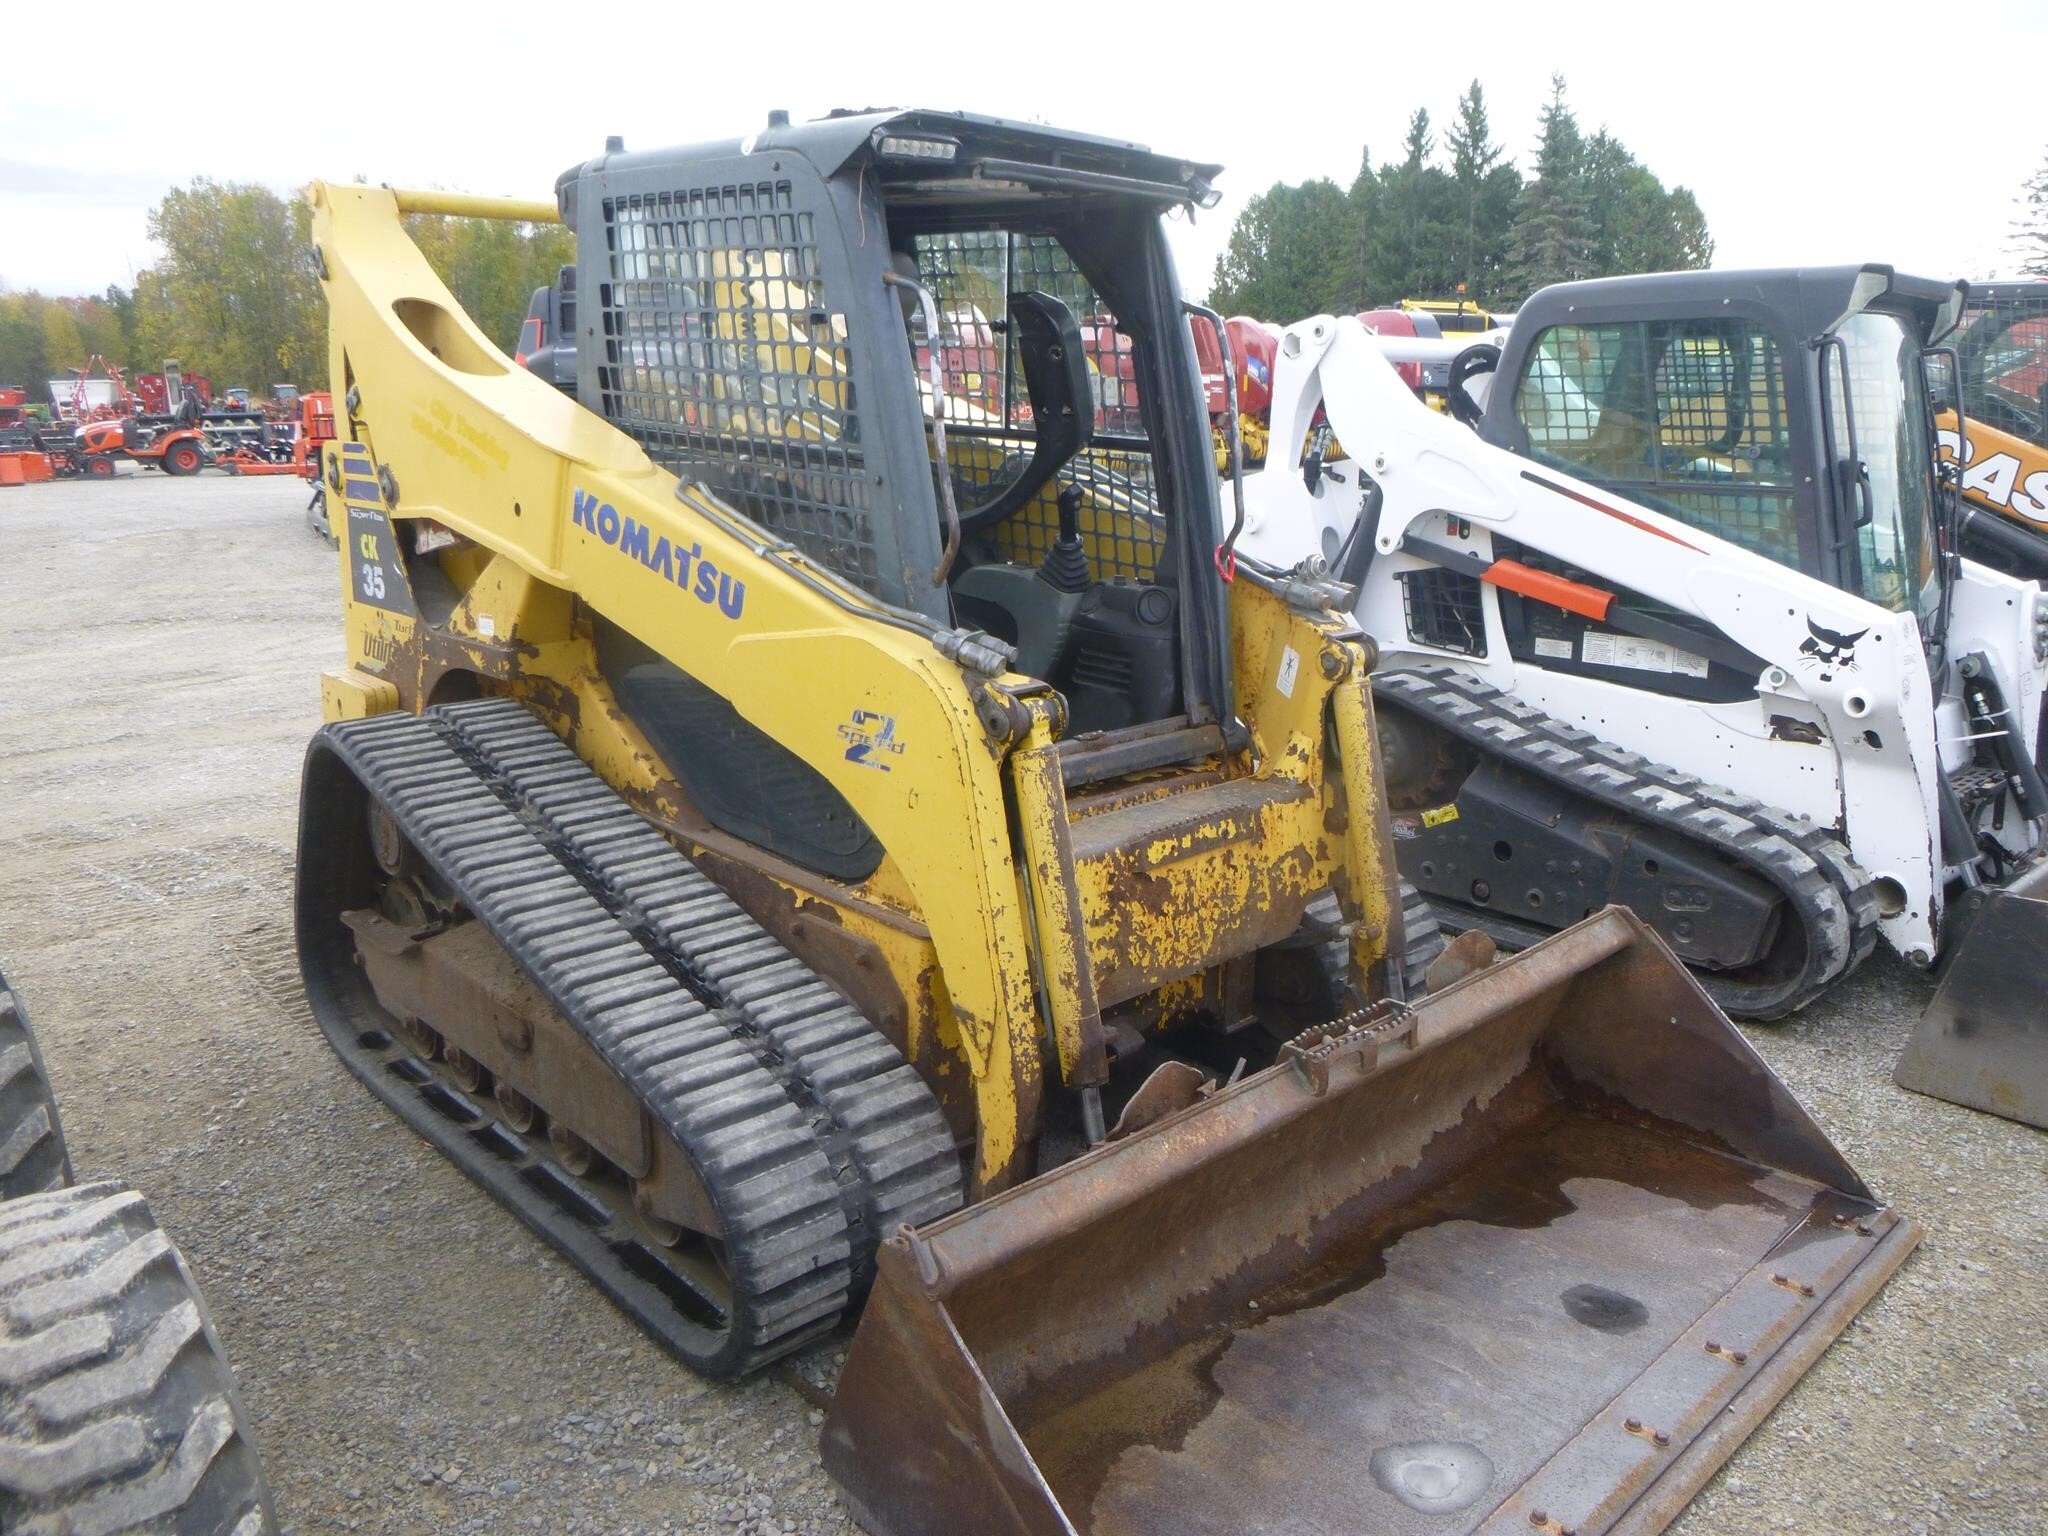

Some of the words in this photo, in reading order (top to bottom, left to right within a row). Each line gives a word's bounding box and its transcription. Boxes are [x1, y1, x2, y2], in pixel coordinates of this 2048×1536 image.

[360, 533, 380, 561] CK
[572, 487, 746, 620] KOMATSU
[362, 563, 386, 600] 35
